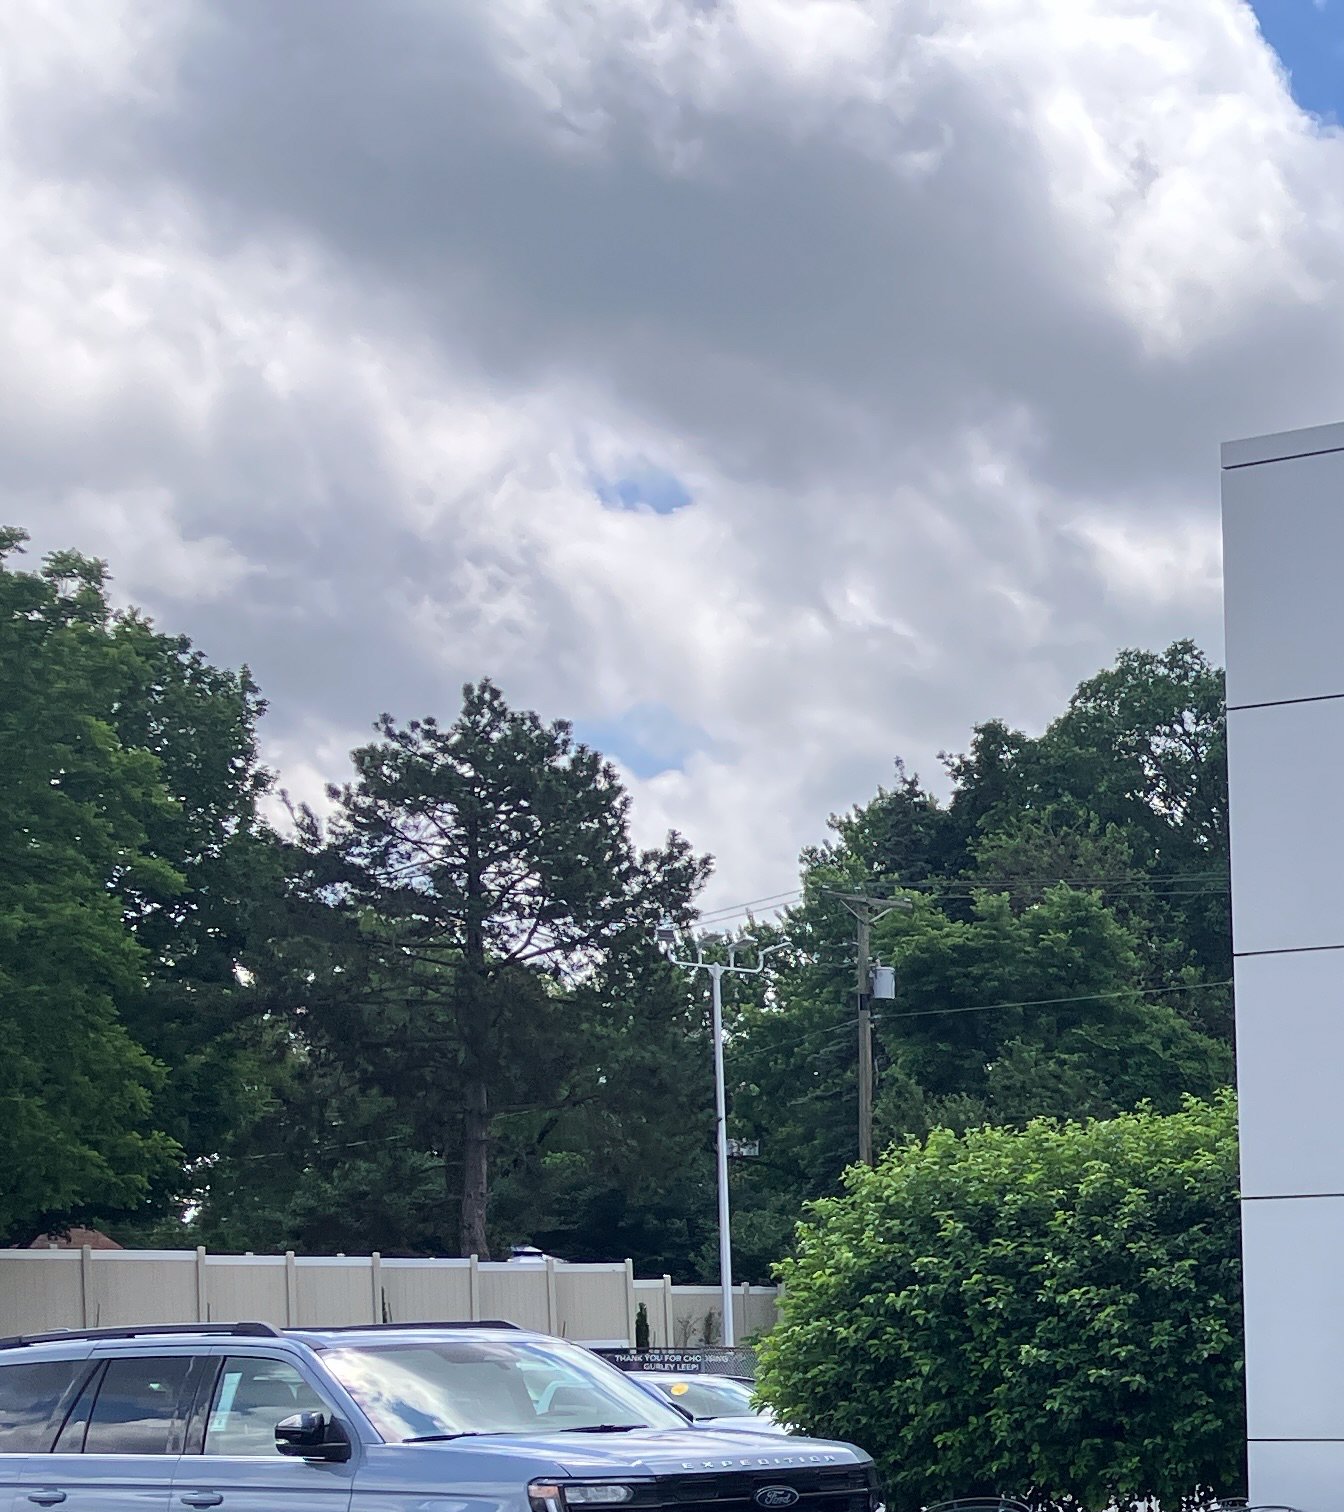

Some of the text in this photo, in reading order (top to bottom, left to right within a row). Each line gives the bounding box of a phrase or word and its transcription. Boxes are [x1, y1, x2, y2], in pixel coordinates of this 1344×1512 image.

[645, 1354, 663, 1362] YOU
[664, 1354, 682, 1362] FOR
[643, 1363, 675, 1371] GURLEY
[681, 1455, 835, 1470] EXPEDITION
